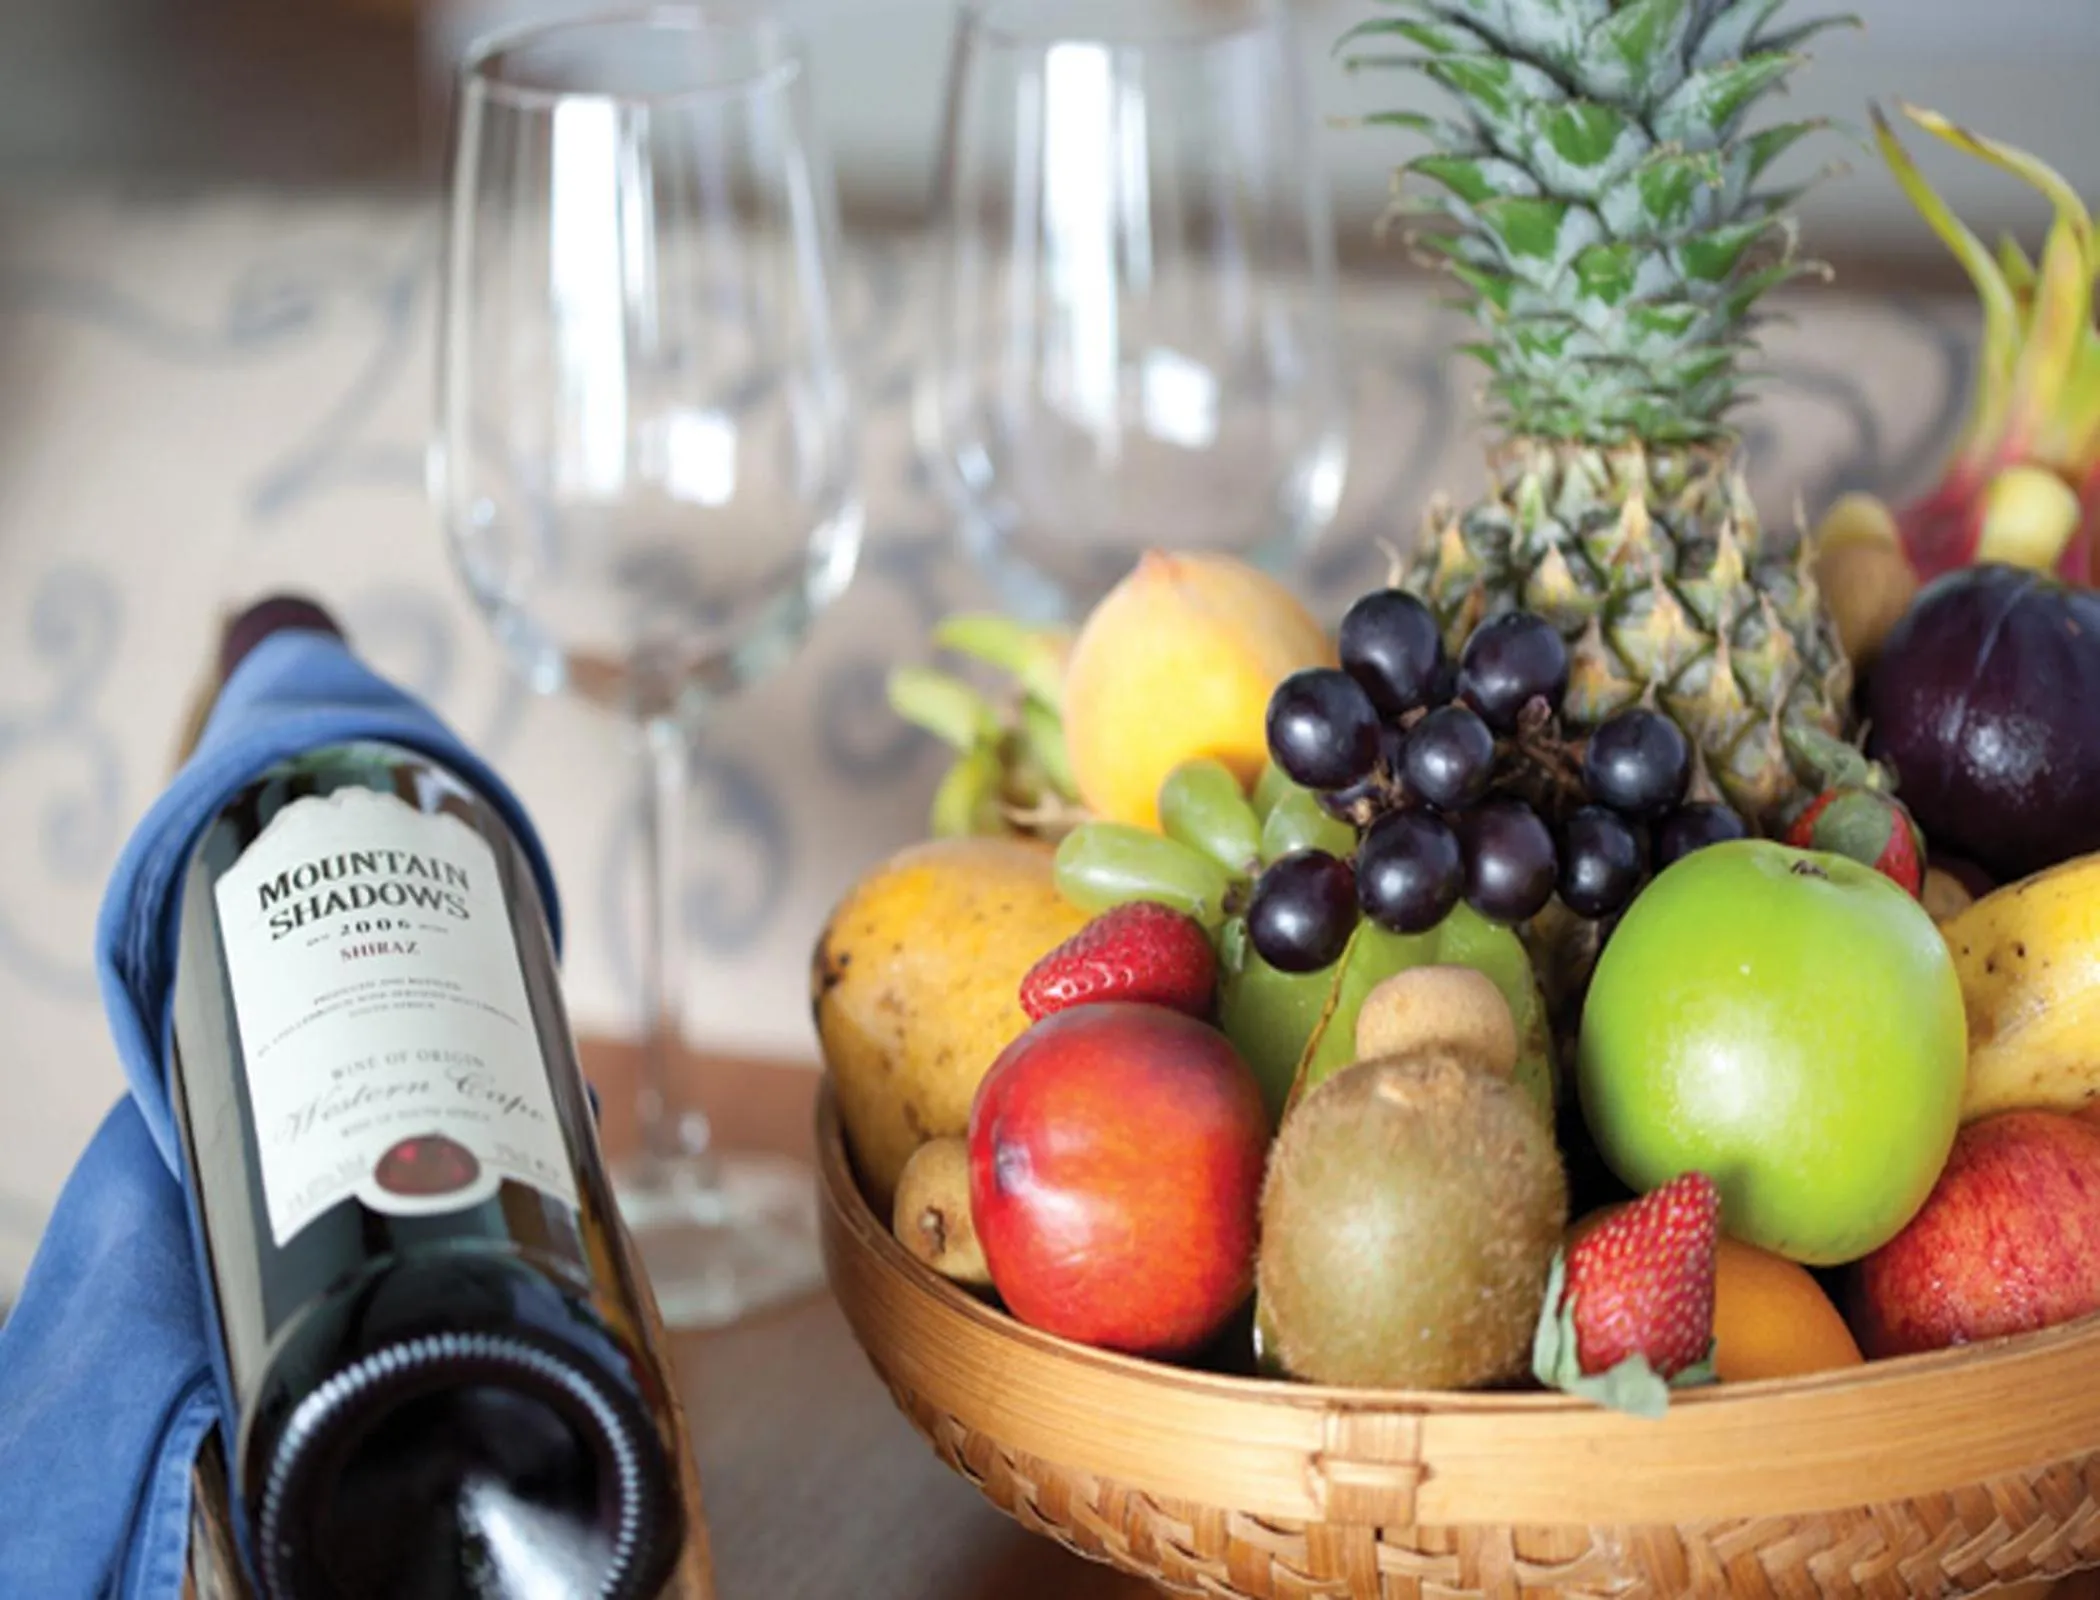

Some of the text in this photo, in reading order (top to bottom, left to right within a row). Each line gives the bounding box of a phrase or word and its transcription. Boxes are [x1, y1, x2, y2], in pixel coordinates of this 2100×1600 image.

[258, 850, 469, 912] MOUNTAIN
[269, 883, 470, 941] SHADOWS
[341, 918, 411, 937] 2006
[340, 941, 420, 961] SHIRAZ
[331, 1048, 486, 1080] WINE OF ORIGIN
